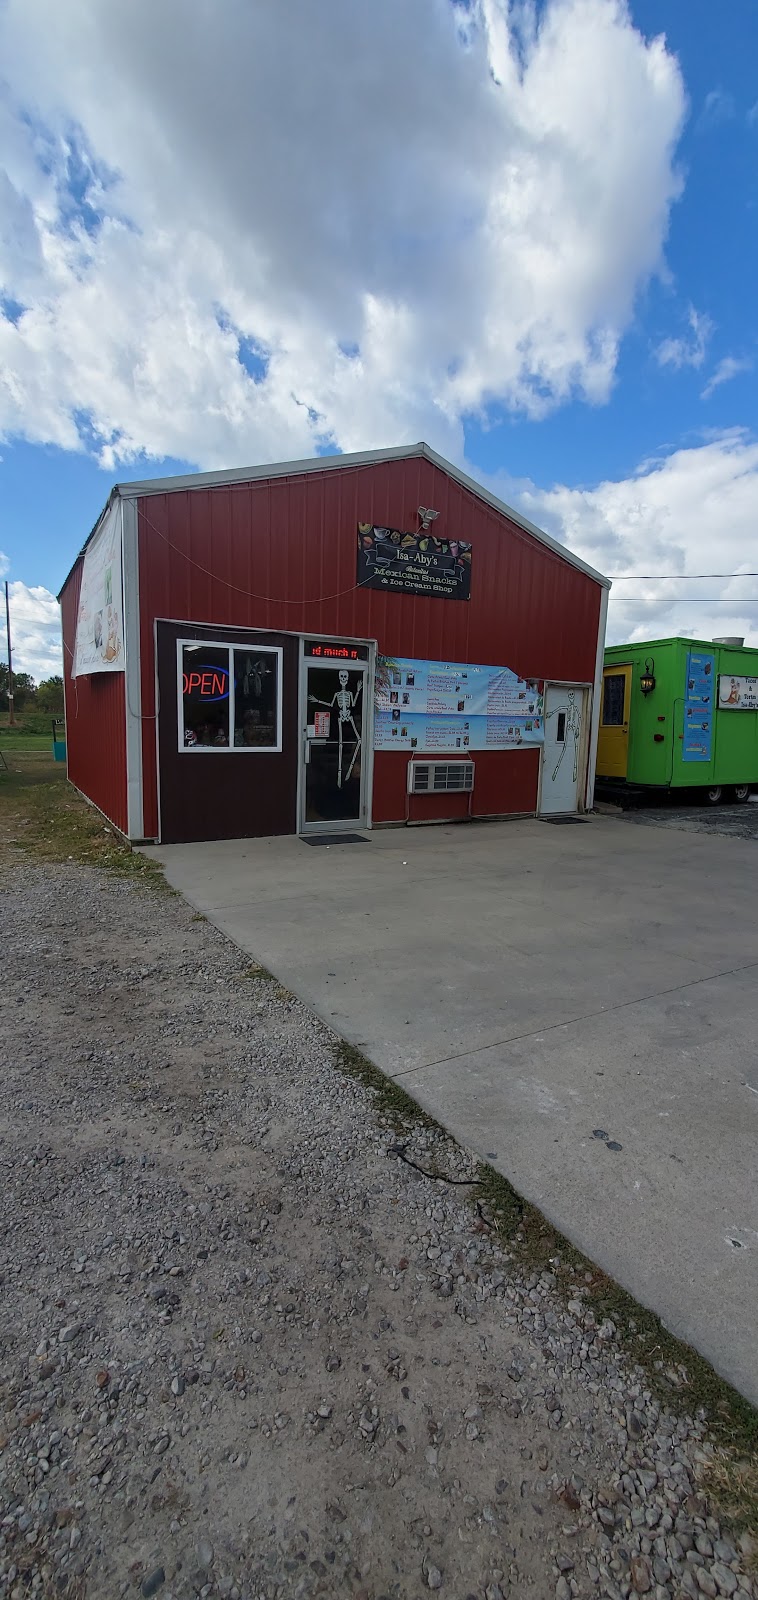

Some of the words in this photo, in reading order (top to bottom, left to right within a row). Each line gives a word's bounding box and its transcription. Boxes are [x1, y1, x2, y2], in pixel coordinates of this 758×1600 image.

[396, 549, 438, 566] Isa-Aby's
[374, 567, 420, 581] Mexican
[421, 574, 458, 586] Snacks
[404, 581, 432, 590] Cream
[432, 584, 452, 593] Shop
[324, 648, 348, 657] much
